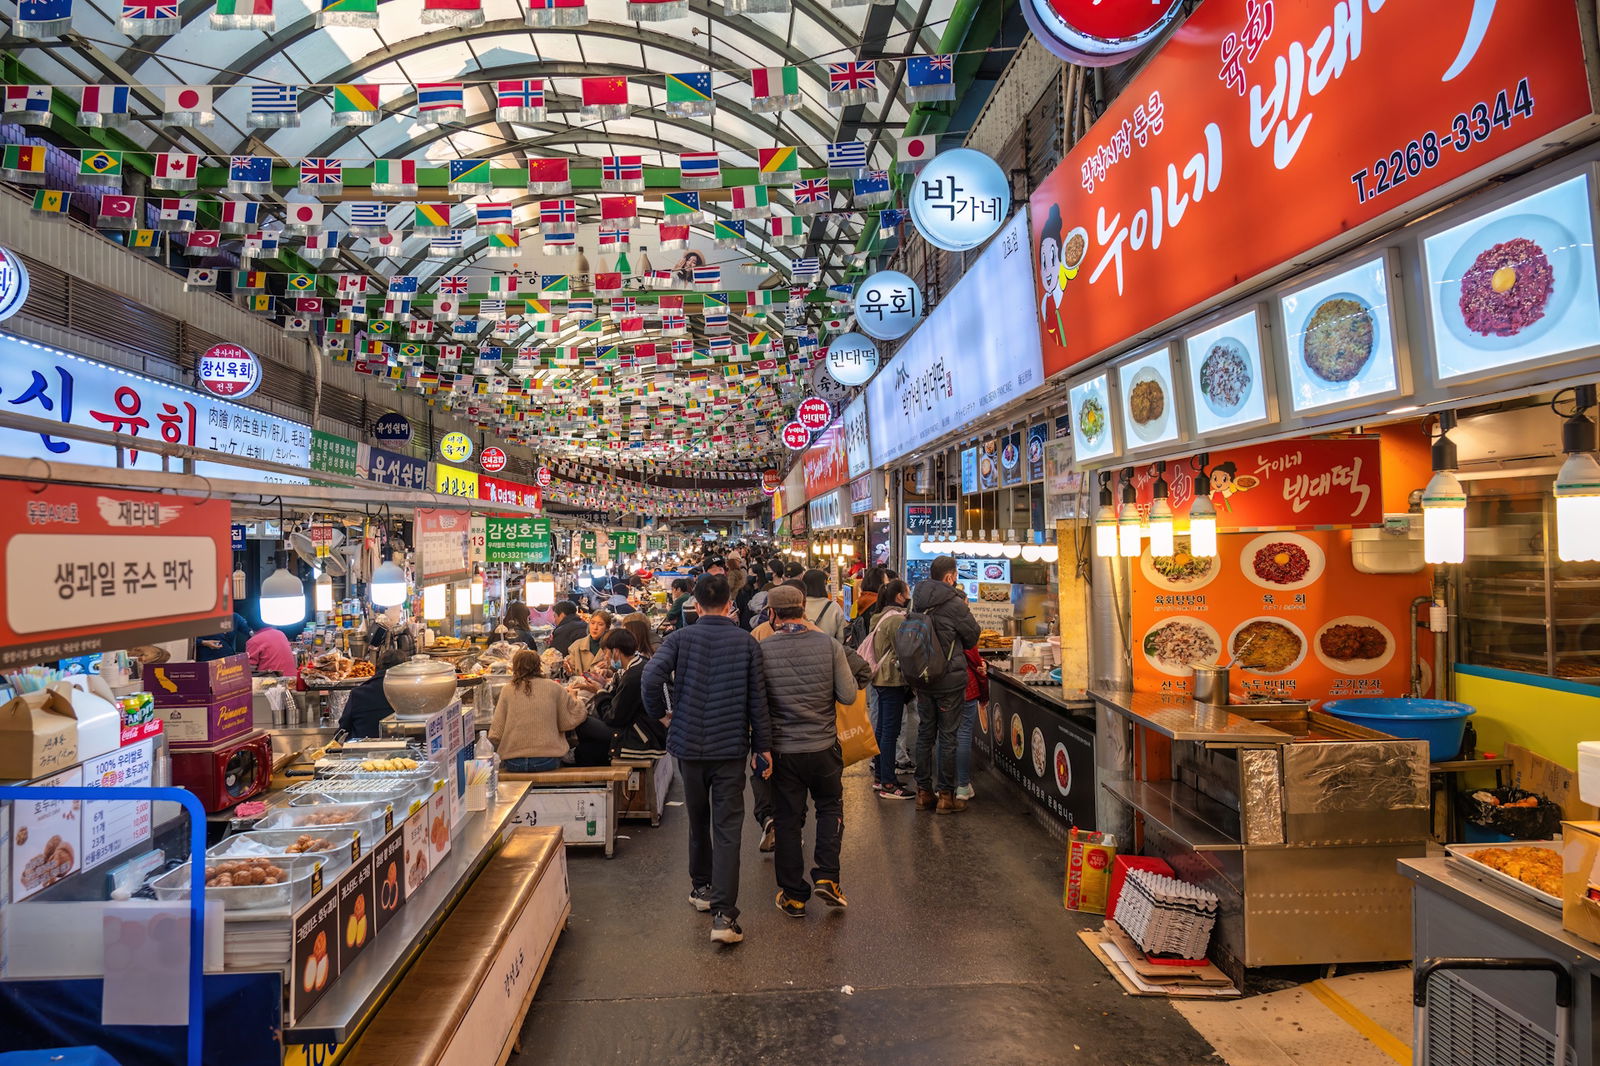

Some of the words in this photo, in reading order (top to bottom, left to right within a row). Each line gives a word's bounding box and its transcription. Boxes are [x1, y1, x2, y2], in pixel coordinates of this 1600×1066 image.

[1219, 0, 1273, 95] 육회
[1081, 120, 1132, 194] 광장시장
[1134, 90, 1165, 149] 통큰
[1352, 77, 1535, 204] T.2268-3344
[921, 176, 1002, 222] 박가네
[1089, 122, 1223, 297] 누이네
[859, 287, 915, 321] 육회
[212, 348, 242, 358] 육사시미
[830, 347, 876, 367] 빈대떡
[202, 360, 252, 379] 창신육회
[216, 382, 234, 393] 전문
[922, 356, 947, 412] 빈대떡
[0, 366, 74, 454] 신
[803, 413, 827, 423] 빈대떡
[376, 422, 409, 435] 유성쉼터
[371, 456, 426, 491] 유성쉼터
[1254, 452, 1303, 479] 누이네
[1282, 456, 1372, 517] 빈대떡
[117, 500, 160, 527] 재라네
[472, 536, 485, 546] 13
[488, 523, 548, 539] 감성호두
[54, 562, 116, 601] 생과일
[122, 562, 157, 594] 쥬스
[163, 559, 194, 591] 먹자
[1154, 595, 1206, 605] 육회탕탕이
[1332, 679, 1381, 690] 고기완자
[96, 758, 117, 775] 100%
[117, 748, 144, 768] 우리쌀로
[125, 760, 150, 780] 호두과자
[1071, 844, 1084, 867] OIL
[1068, 870, 1082, 909] CORN
